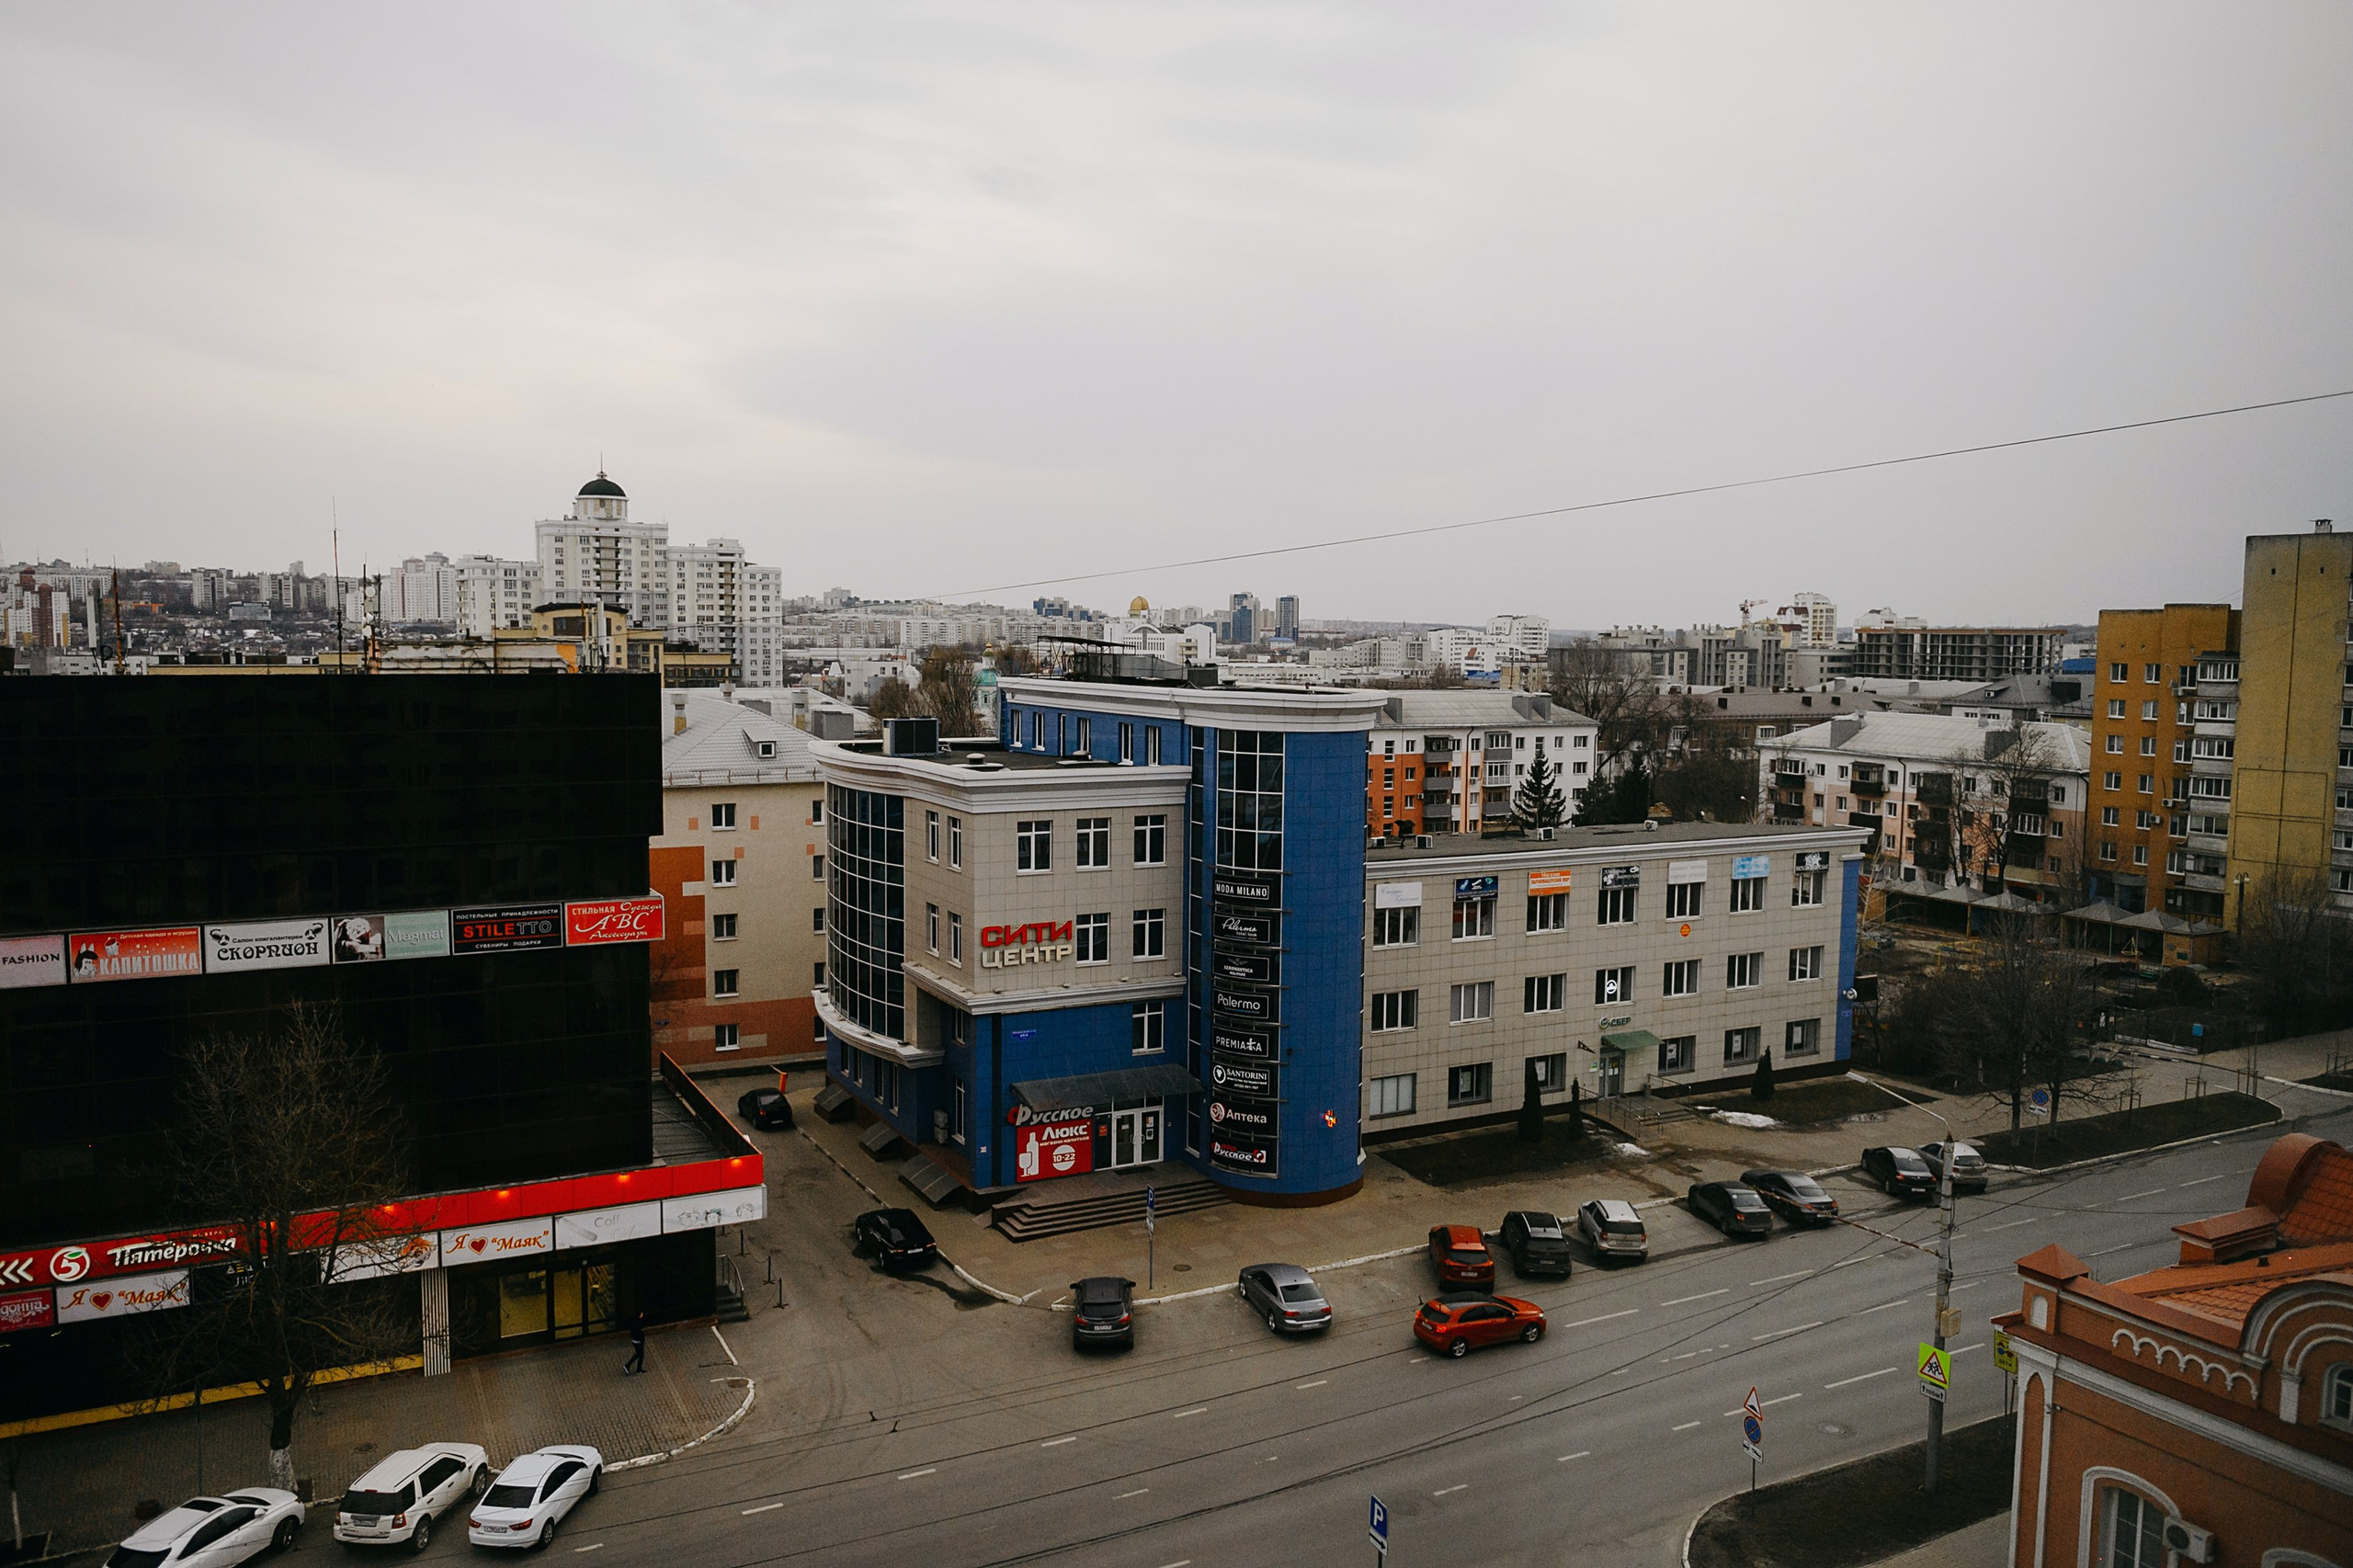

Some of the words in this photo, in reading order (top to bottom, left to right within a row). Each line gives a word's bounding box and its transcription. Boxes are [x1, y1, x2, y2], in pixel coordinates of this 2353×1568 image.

[1215, 882, 1234, 894] MODA
[1236, 885, 1267, 897] MILANO
[456, 912, 497, 920] ПОСТЕЛЬНЫЕ
[501, 909, 559, 917] ПРИНАДЛЕЖНОСТИ
[572, 905, 615, 915] СТИЛЬНАЯ
[463, 920, 552, 938] STILETTO
[981, 920, 1073, 948] СИТИ
[2, 953, 61, 966] FASHION
[217, 942, 319, 961] СКОРПИОН
[981, 944, 1073, 969] ЦЕНТР
[98, 952, 199, 976] КАПИТОШКА
[1217, 994, 1261, 1010] Palermo
[1609, 1016, 1631, 1027] СБЕР
[1226, 1068, 1267, 1080] SANTORINI
[1015, 1104, 1094, 1127] Русское
[1226, 1108, 1267, 1124] Аптека
[1041, 1124, 1088, 1141] Люкс
[1052, 1153, 1075, 1163] 10-22
[1213, 1142, 1253, 1161] Русское
[446, 1233, 471, 1254] Я
[61, 1289, 90, 1310] Я
[1926, 1388, 1940, 1399] 100м
[1373, 1502, 1384, 1527] P
